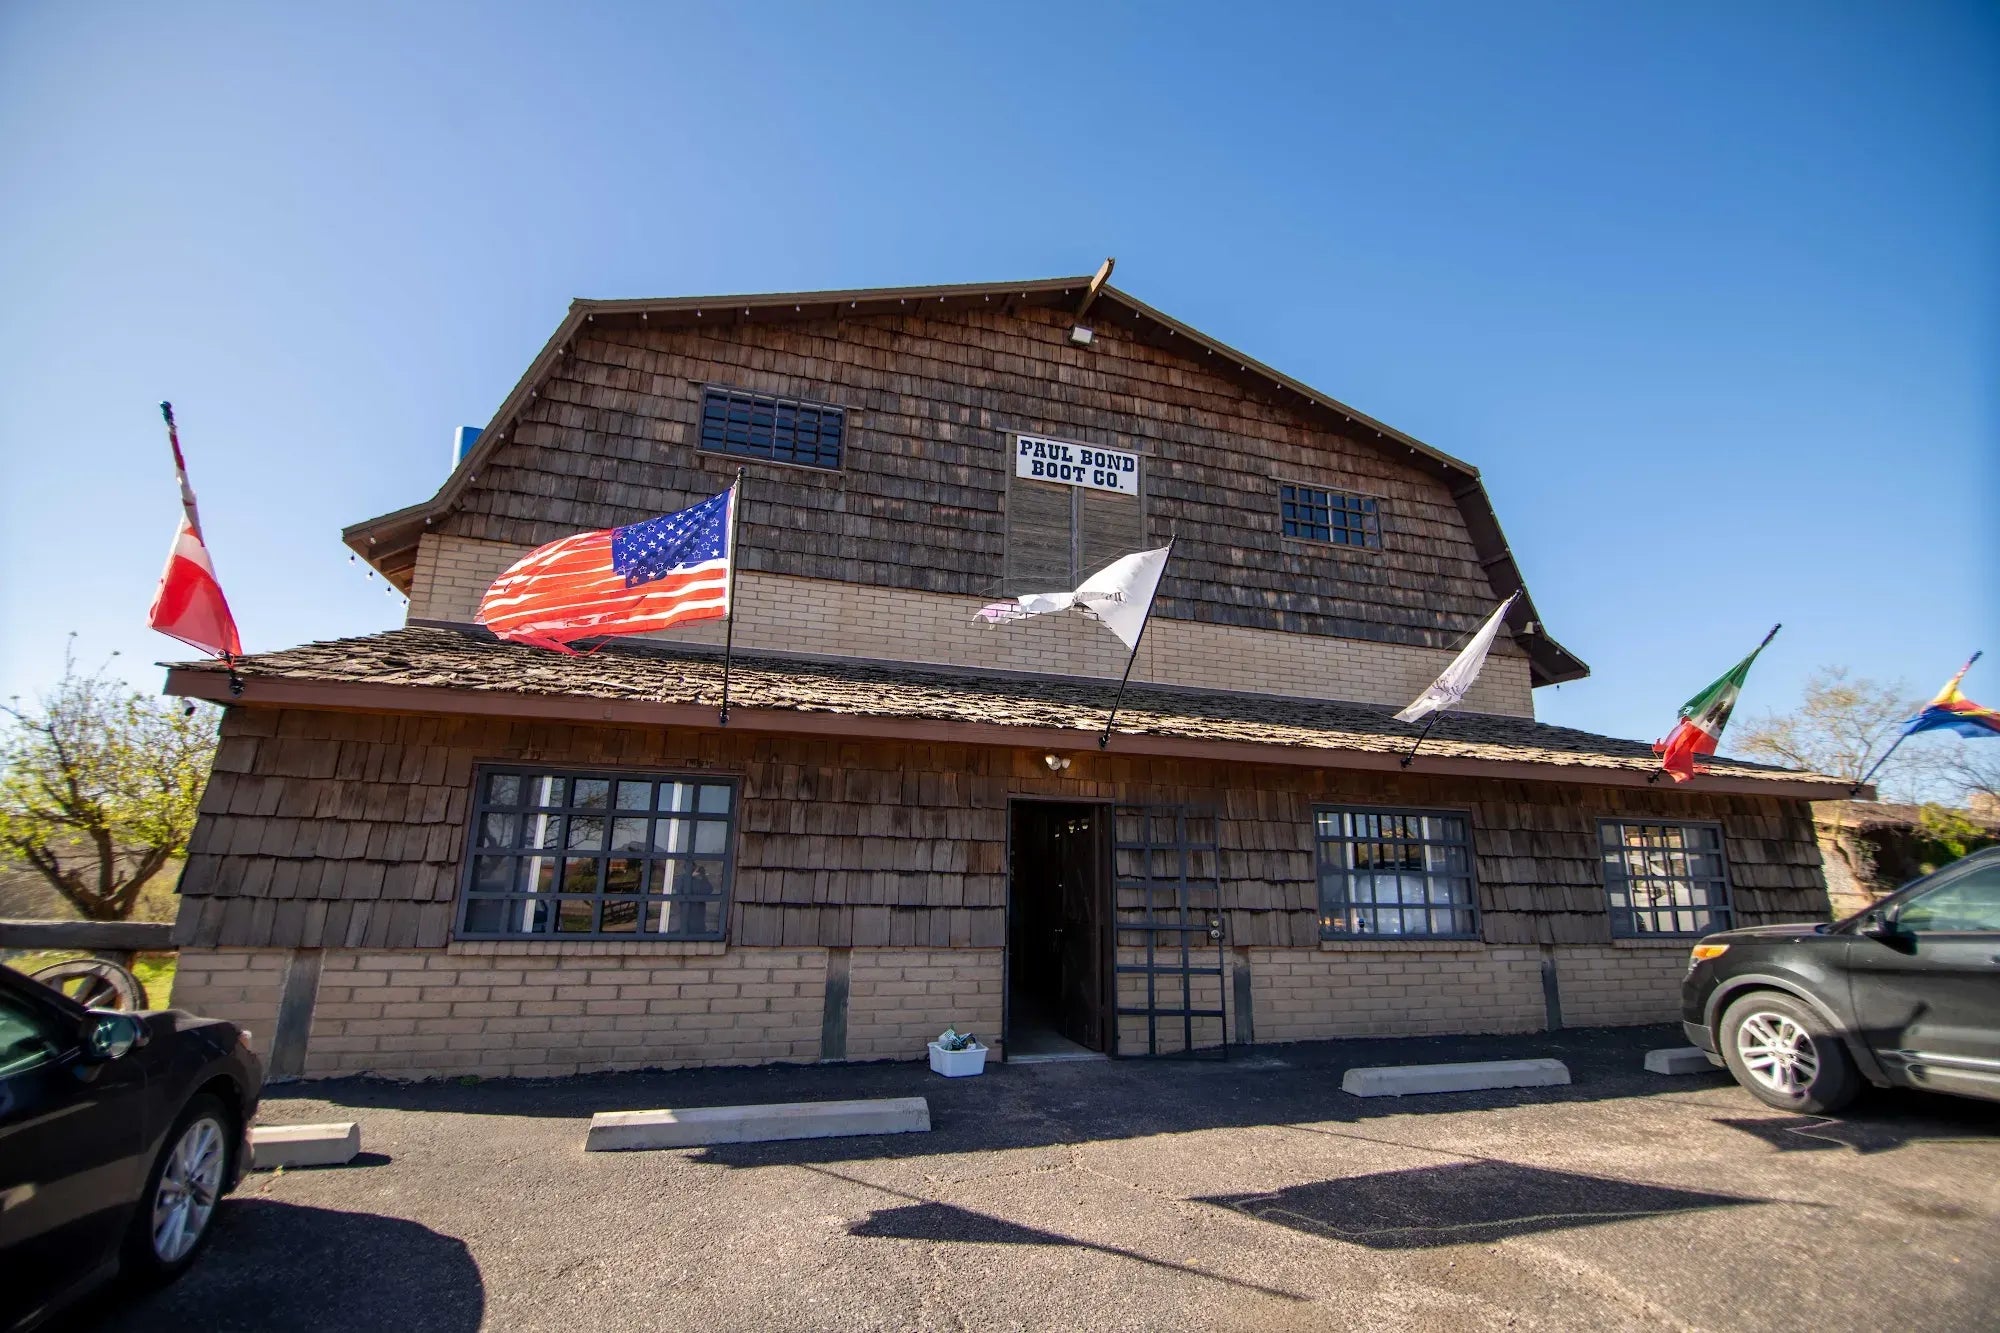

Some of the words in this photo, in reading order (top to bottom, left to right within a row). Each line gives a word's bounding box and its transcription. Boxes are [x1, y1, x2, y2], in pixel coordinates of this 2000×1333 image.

[1020, 440, 1073, 462] PAUL
[1080, 450, 1134, 472] BOND
[1031, 460, 1085, 482] BOOT
[1093, 469, 1124, 489] CO.
